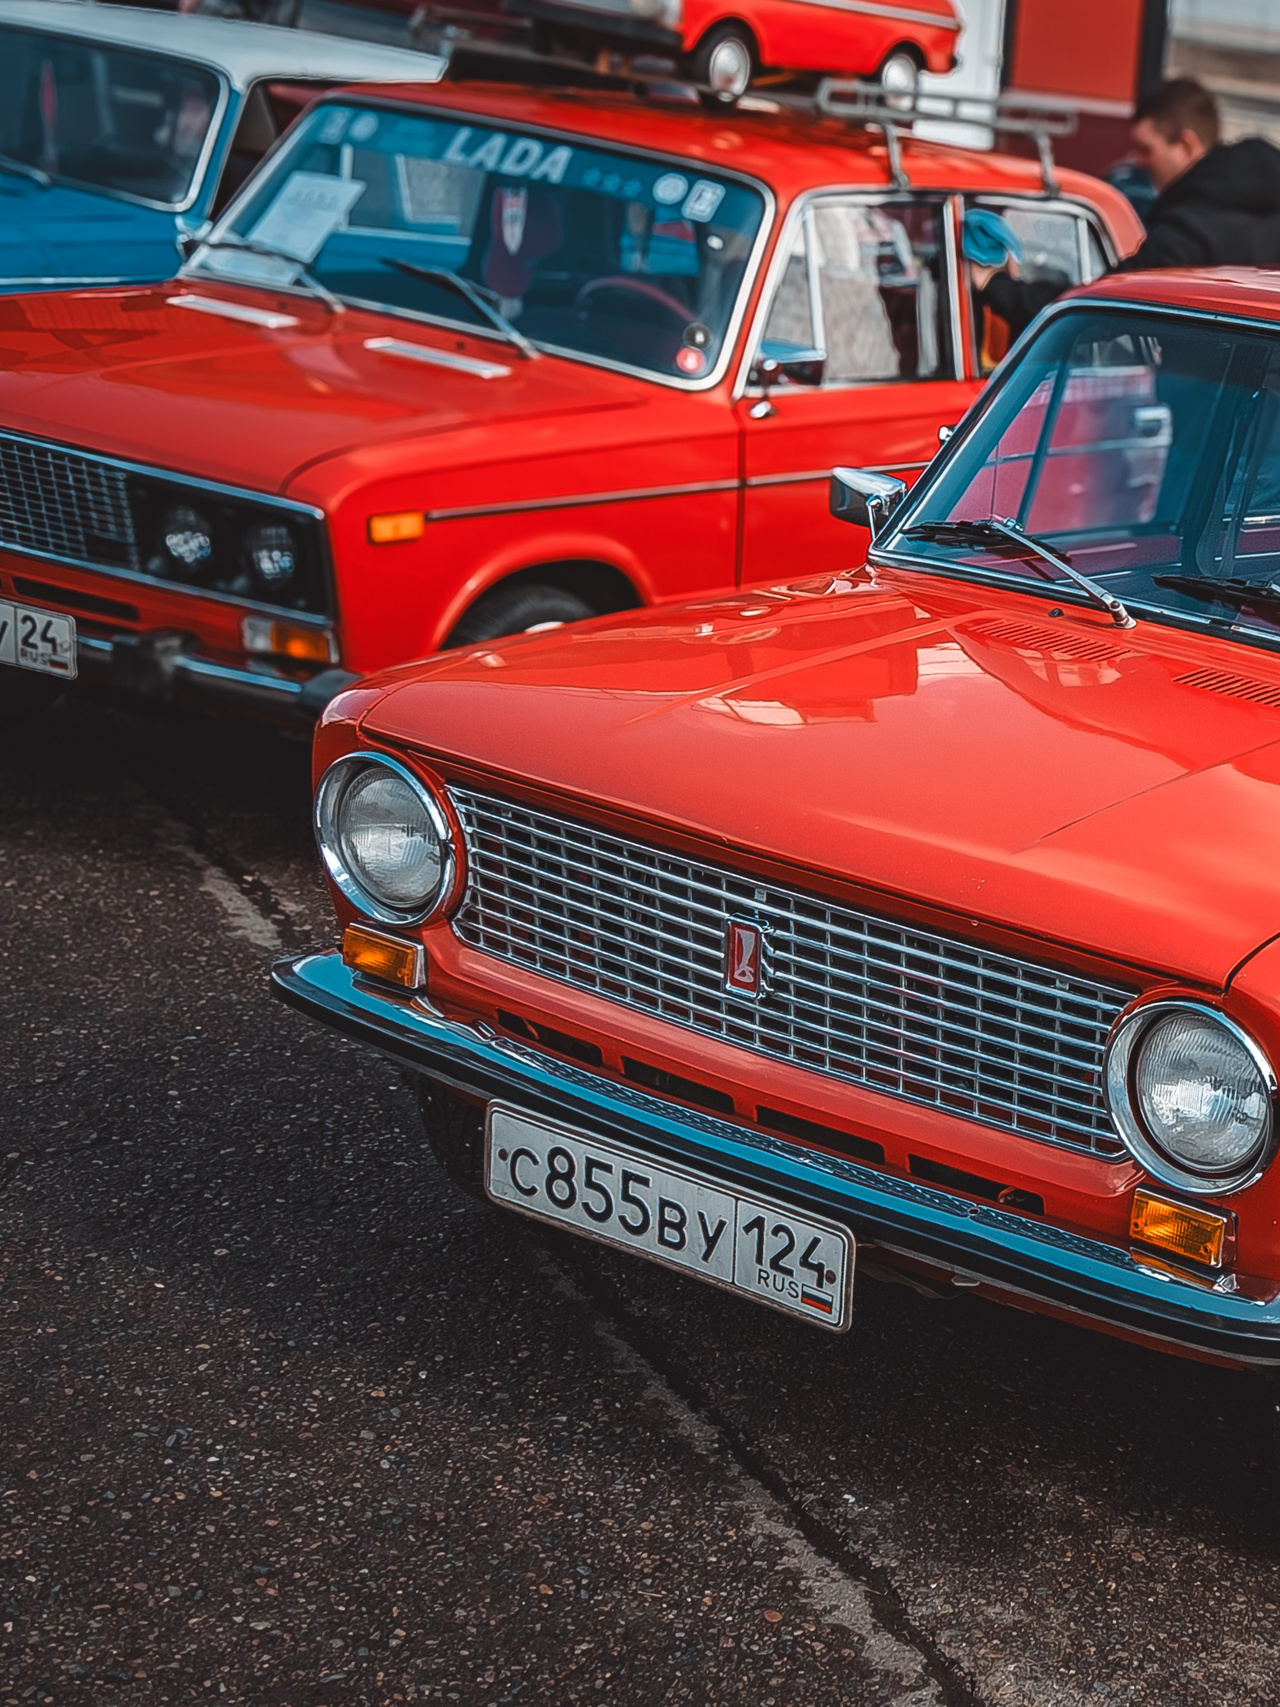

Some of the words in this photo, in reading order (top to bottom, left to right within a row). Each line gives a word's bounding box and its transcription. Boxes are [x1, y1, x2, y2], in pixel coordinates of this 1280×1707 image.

[442, 125, 574, 184] LADA
[21, 614, 58, 655] 24
[742, 1214, 827, 1290] 124
[757, 1267, 800, 1299] RUS
